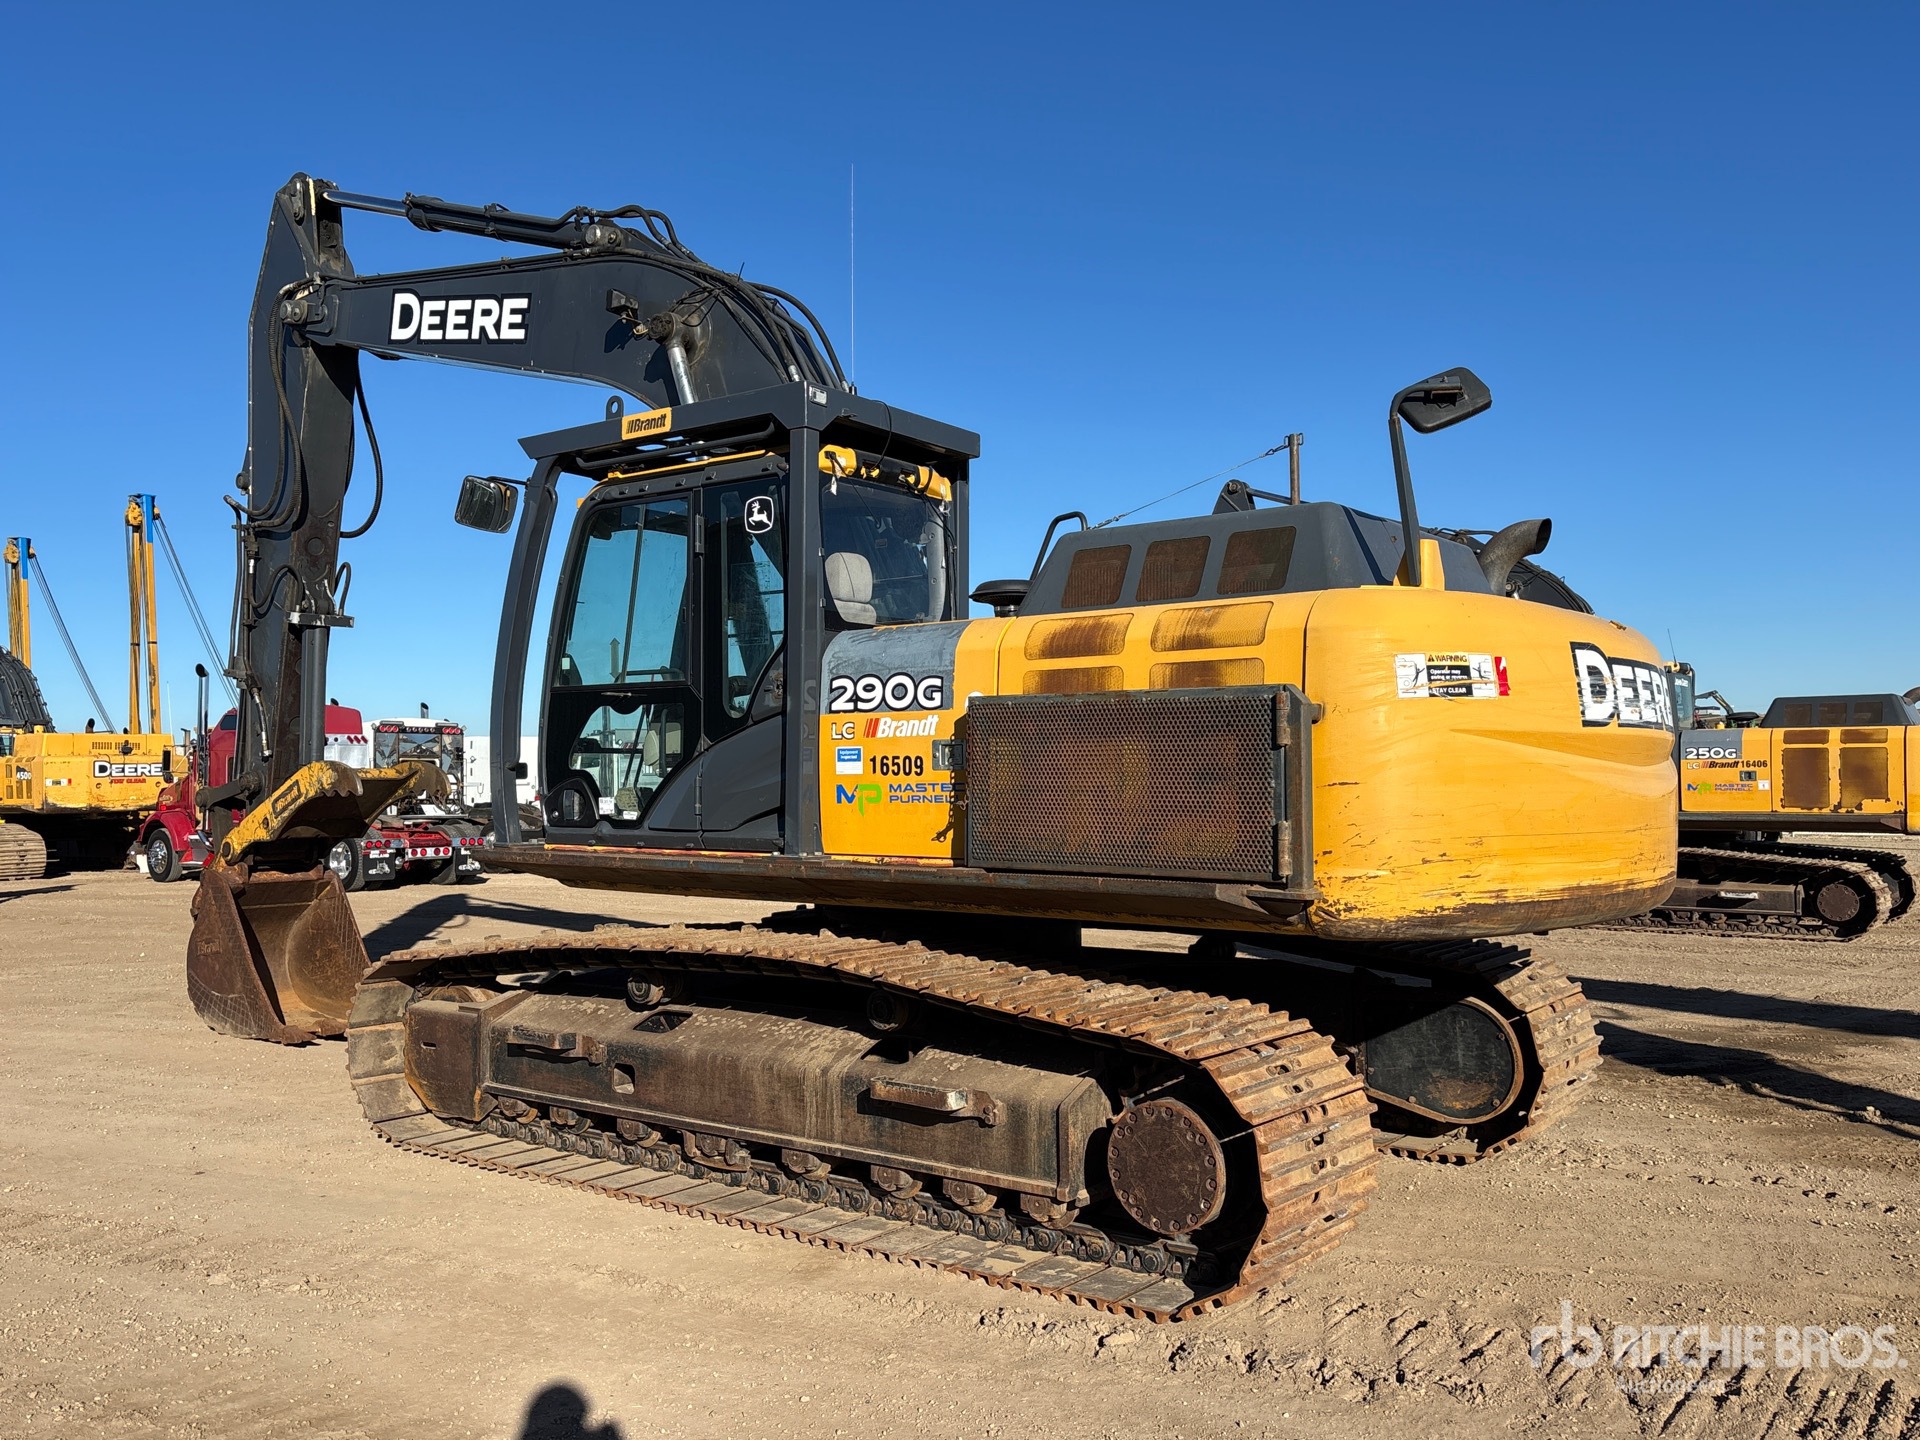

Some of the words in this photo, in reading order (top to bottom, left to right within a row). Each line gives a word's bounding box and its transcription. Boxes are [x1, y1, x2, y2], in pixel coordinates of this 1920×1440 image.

[390, 291, 530, 341] DEERE
[632, 413, 667, 433] Brandt
[830, 673, 943, 712] 290G
[831, 722, 855, 740] LC
[876, 715, 939, 738] Brandt
[1686, 747, 1738, 759] 250G
[94, 761, 163, 777] DEERE
[869, 755, 924, 776] 16509
[1708, 761, 1739, 769] Brandt
[1740, 760, 1768, 768] 16406
